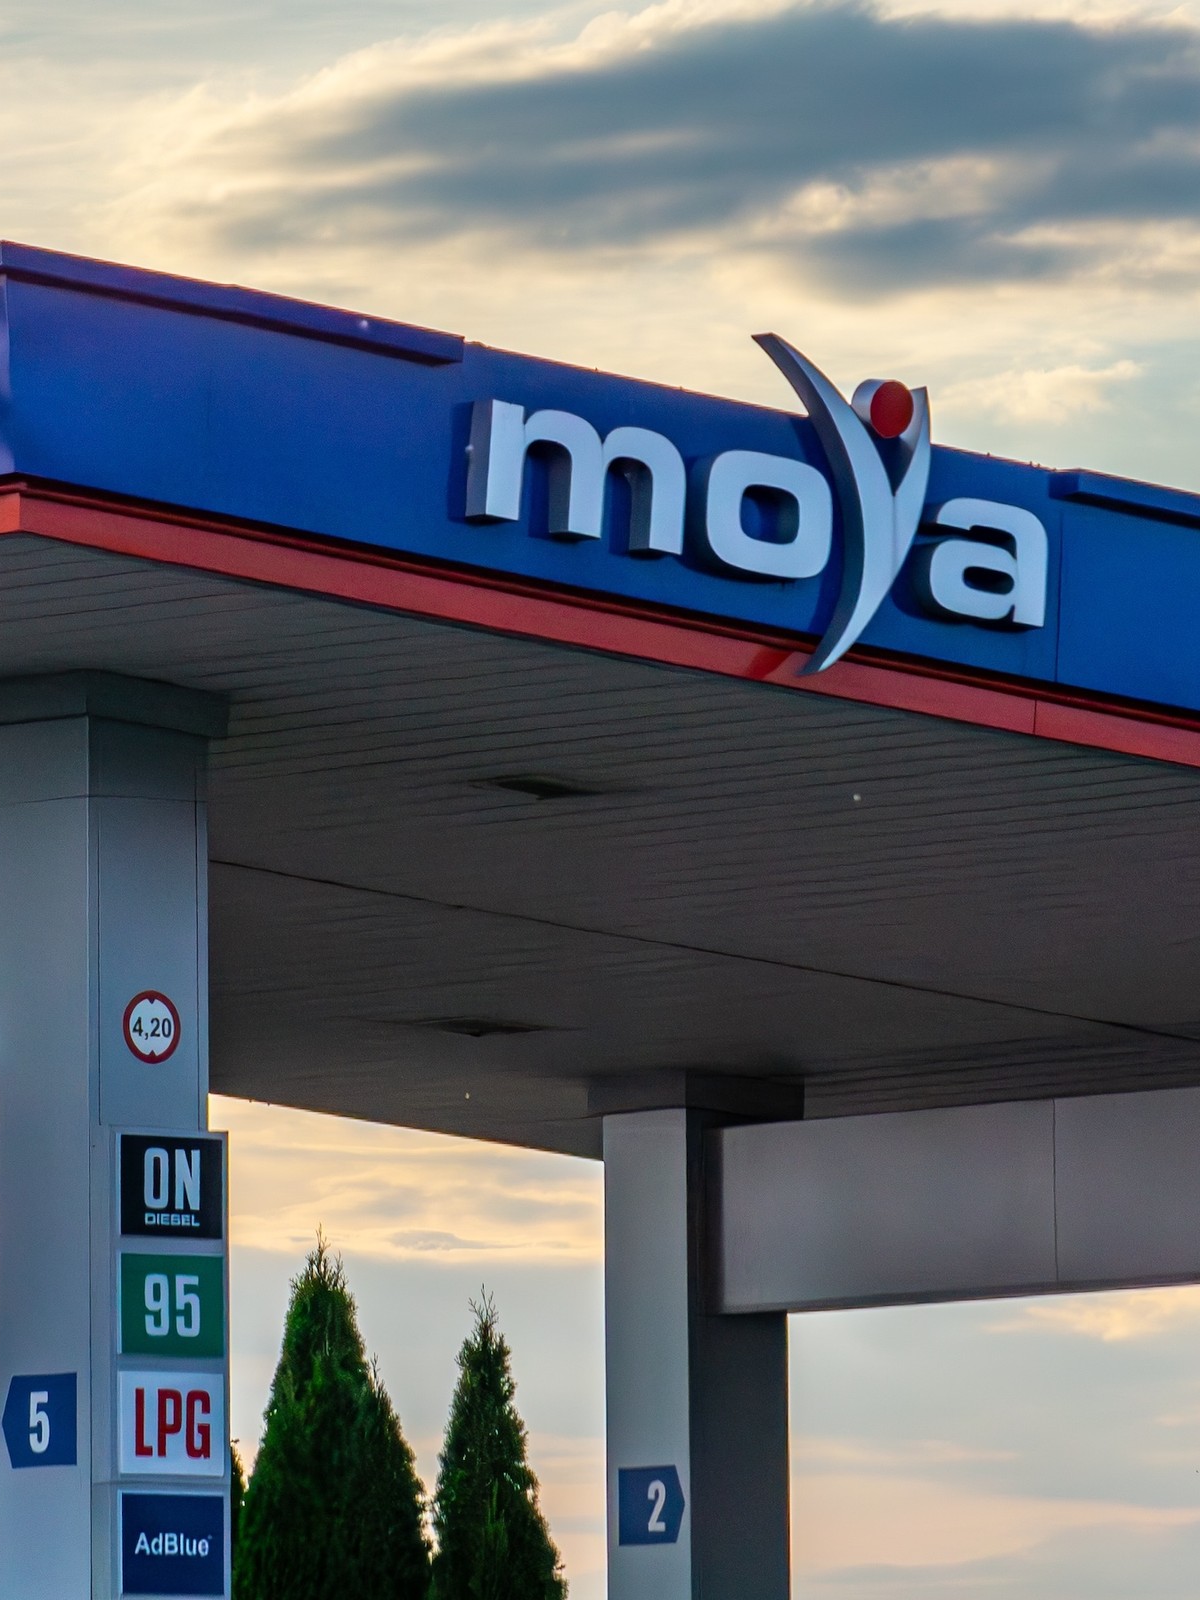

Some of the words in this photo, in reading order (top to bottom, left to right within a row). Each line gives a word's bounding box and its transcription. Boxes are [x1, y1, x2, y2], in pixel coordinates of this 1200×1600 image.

[132, 1017, 172, 1040] 4,20
[144, 1147, 201, 1211] ON
[144, 1212, 200, 1227] DIESEL
[144, 1273, 201, 1338] 95
[29, 1391, 50, 1453] 5
[135, 1387, 211, 1460] LPG
[647, 1479, 666, 1532] 2
